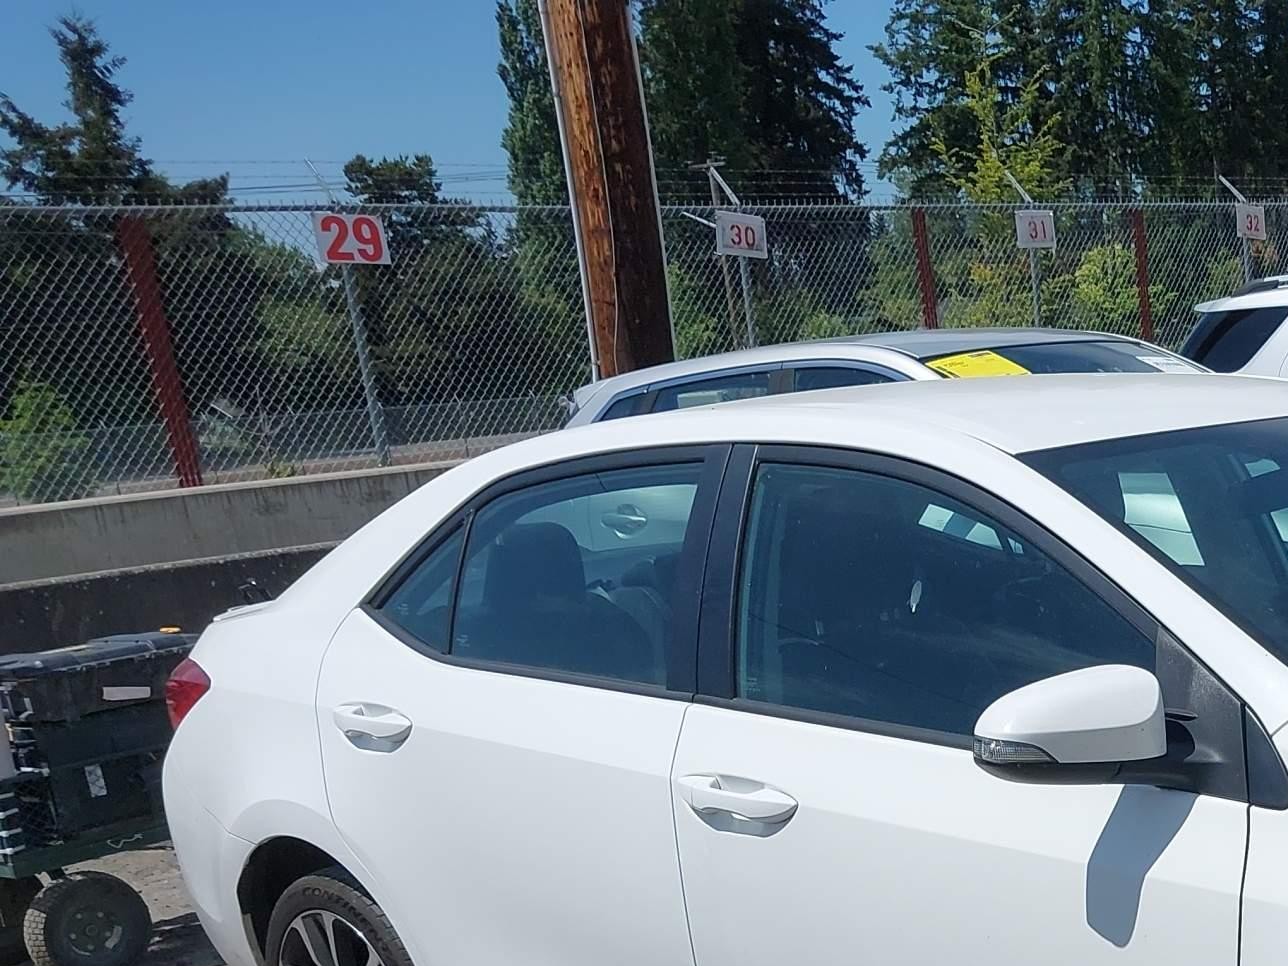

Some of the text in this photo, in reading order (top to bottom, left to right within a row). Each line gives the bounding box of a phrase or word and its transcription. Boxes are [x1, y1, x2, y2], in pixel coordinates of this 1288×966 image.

[1028, 220, 1046, 239] 31
[1246, 213, 1260, 232] 32
[321, 215, 383, 262] 29
[730, 224, 755, 247] 30
